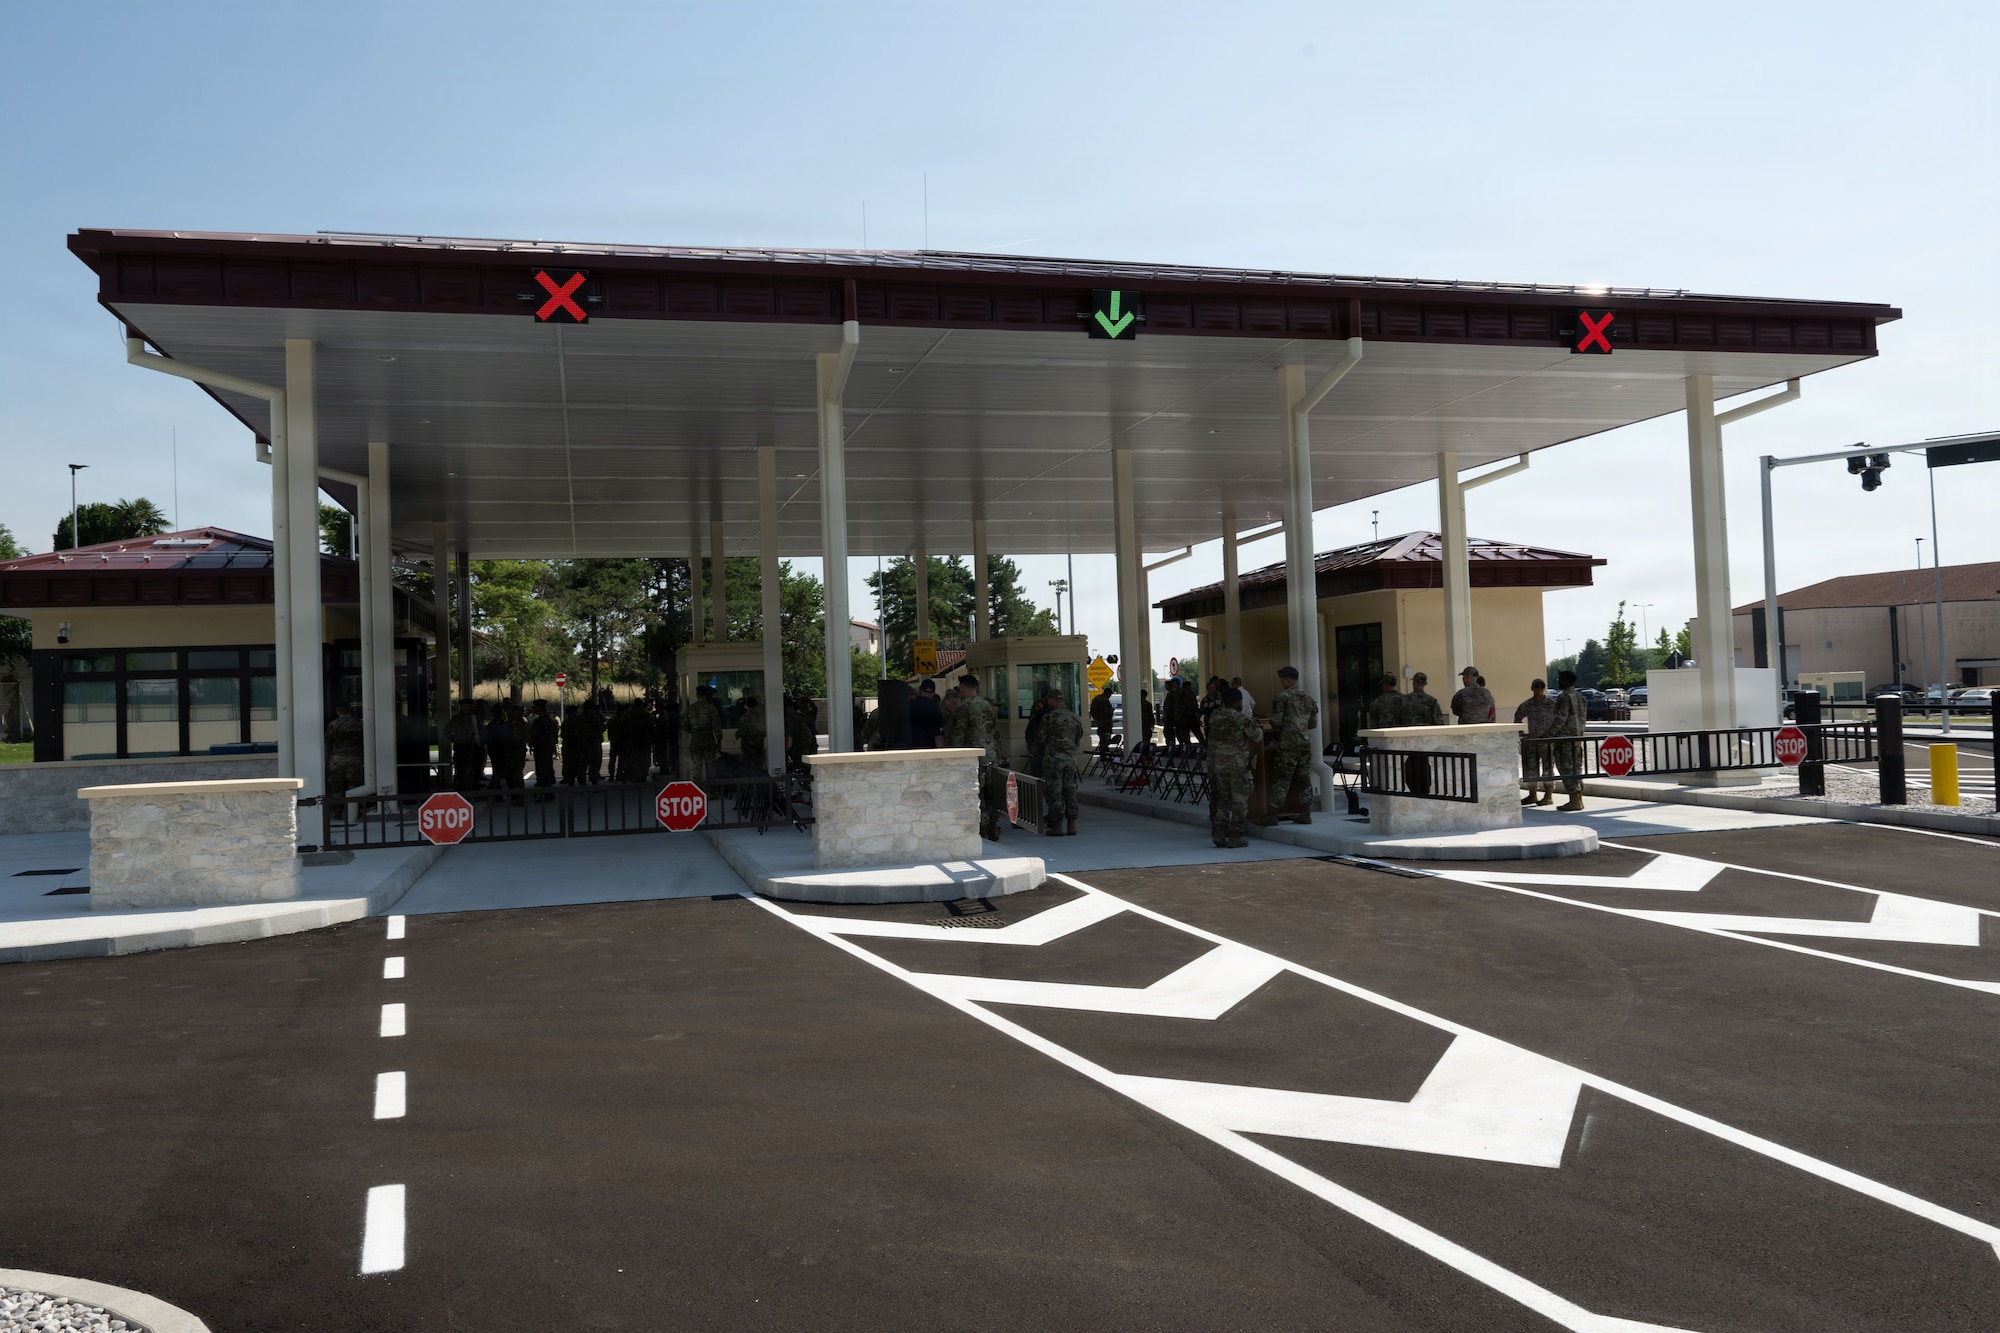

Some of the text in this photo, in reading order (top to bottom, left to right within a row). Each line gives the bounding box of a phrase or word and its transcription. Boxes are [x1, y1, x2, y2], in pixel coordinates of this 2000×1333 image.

[1601, 747, 1633, 765] STOP
[1776, 738, 1805, 755] STOP
[660, 796, 703, 817] STOP
[422, 807, 470, 830] STOP
